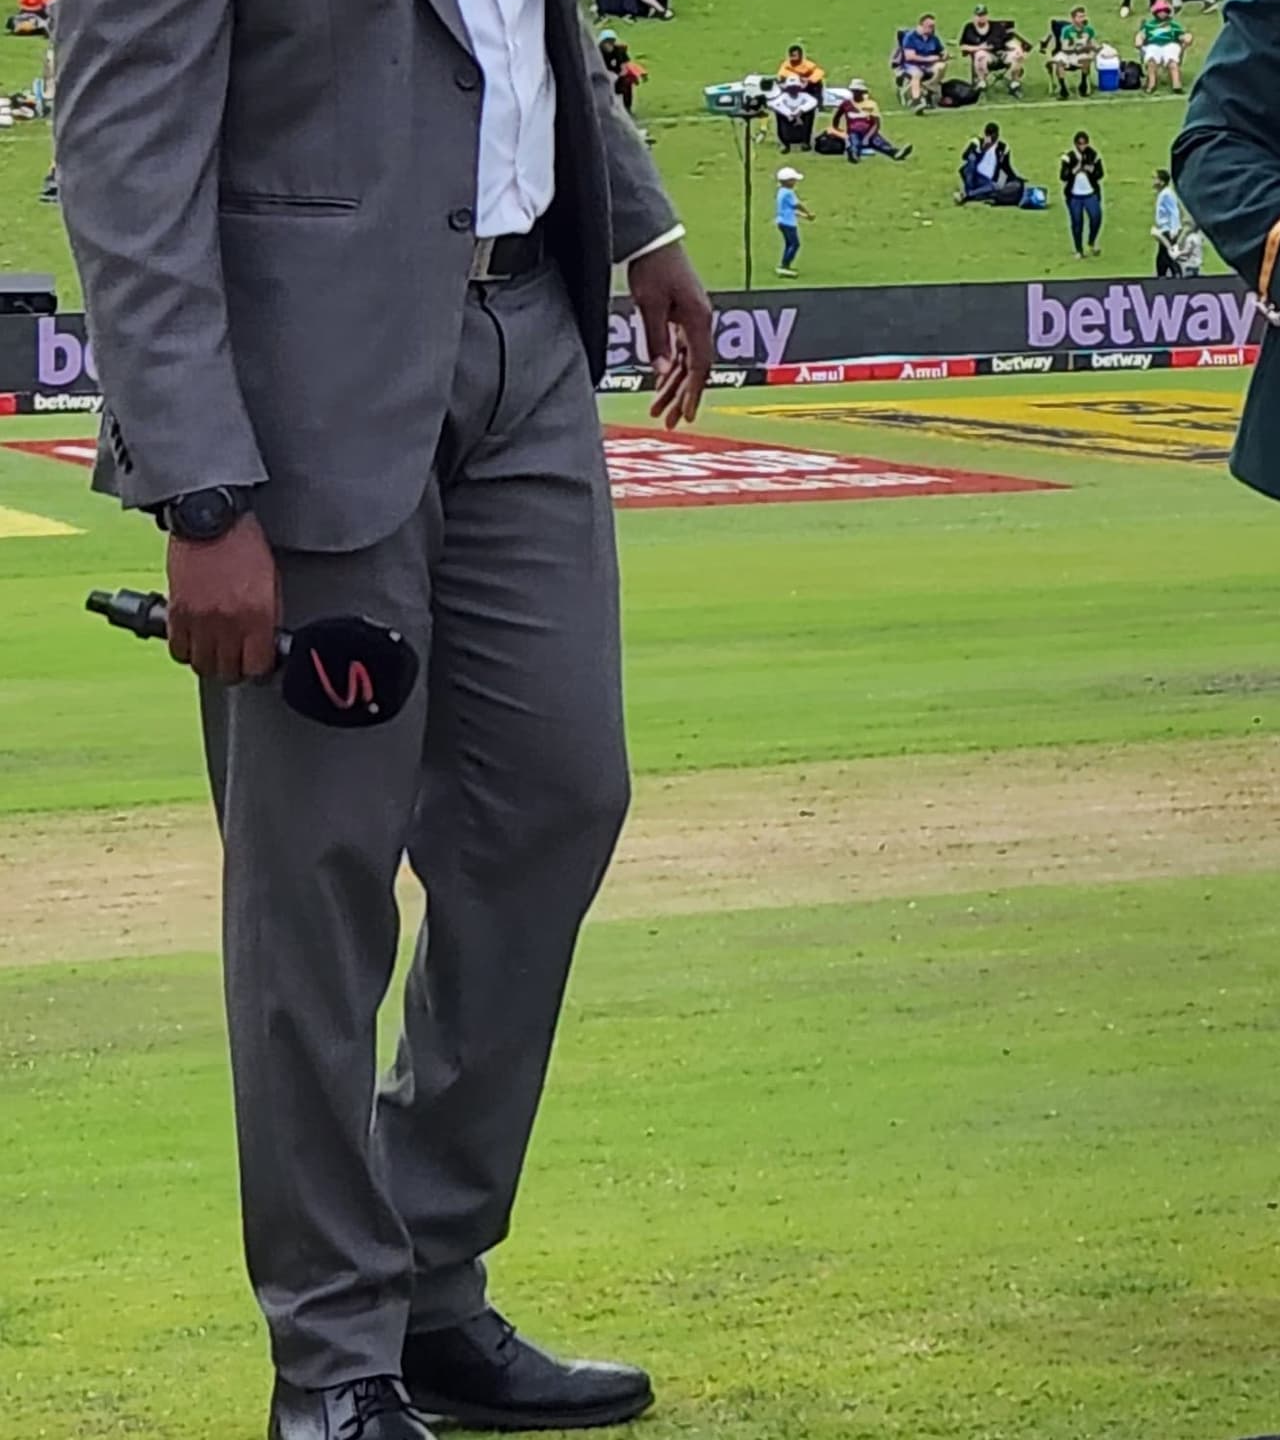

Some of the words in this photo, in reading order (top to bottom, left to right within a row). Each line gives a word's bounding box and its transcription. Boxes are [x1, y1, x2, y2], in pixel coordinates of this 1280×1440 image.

[1027, 283, 1258, 347] betway
[606, 306, 798, 365] etay
[992, 355, 1053, 372] betway
[1091, 352, 1152, 370] betway
[1197, 349, 1244, 366] Amul
[795, 365, 845, 383] Amul
[900, 361, 948, 380] Amul
[34, 392, 104, 413] betway
